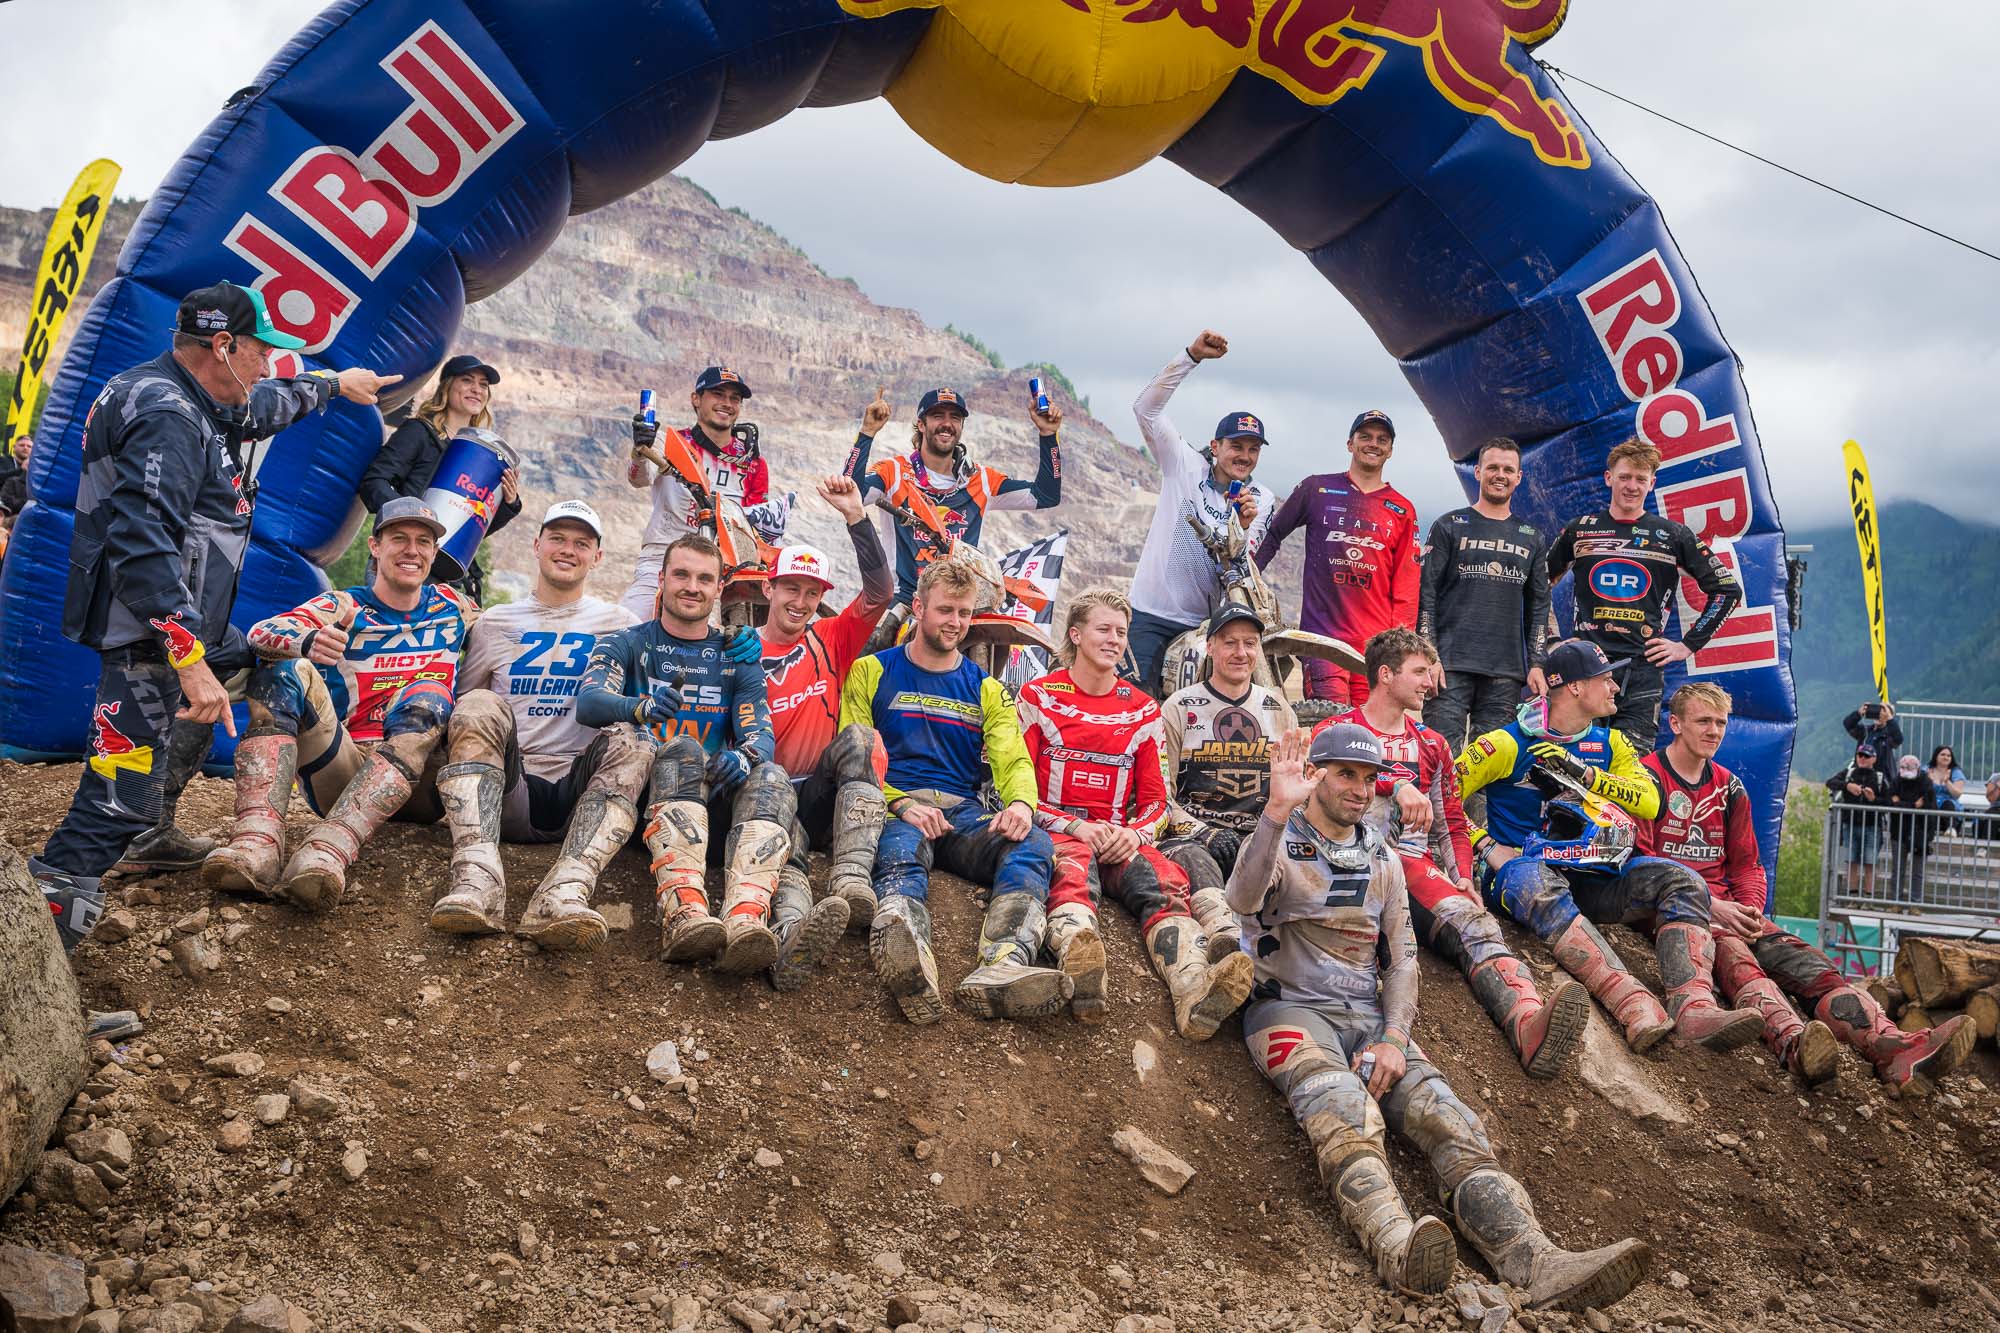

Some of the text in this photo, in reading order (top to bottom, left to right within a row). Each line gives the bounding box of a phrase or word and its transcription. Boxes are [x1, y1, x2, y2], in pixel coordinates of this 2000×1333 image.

[269, 19, 525, 280] Bull
[1579, 250, 1740, 466] Red
[455, 473, 488, 500] Red
[1326, 531, 1385, 551] Beta
[1460, 537, 1530, 559] hebo
[790, 564, 820, 575] Red Bull
[1458, 562, 1487, 573] Sound
[1600, 573, 1639, 589] OR
[1602, 609, 1643, 620] FRESCO
[350, 616, 459, 650] FXR
[509, 631, 597, 676] 23
[527, 706, 571, 717] ECONT
[898, 694, 981, 717] SHERCO
[1071, 770, 1112, 786] F61
[1597, 780, 1642, 807] KENNY
[1543, 845, 1599, 859] Red Bull
[1662, 841, 1725, 857] EUROTEK
